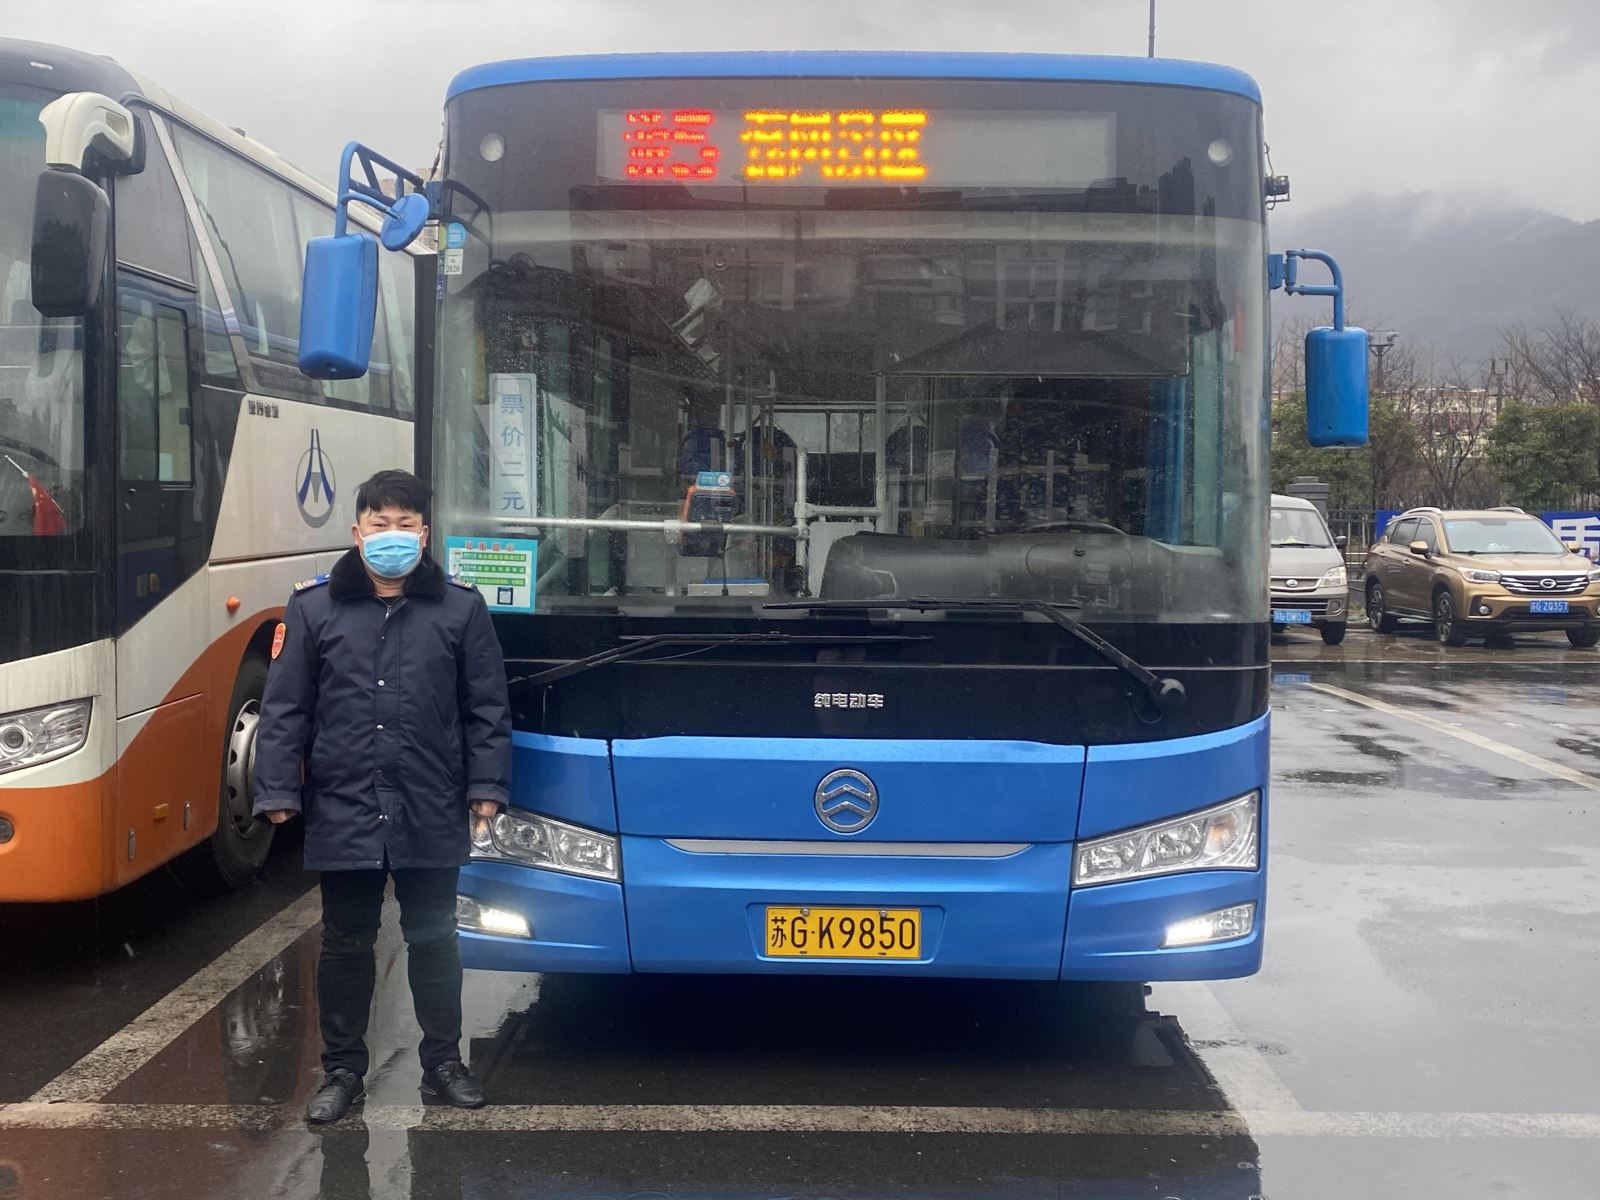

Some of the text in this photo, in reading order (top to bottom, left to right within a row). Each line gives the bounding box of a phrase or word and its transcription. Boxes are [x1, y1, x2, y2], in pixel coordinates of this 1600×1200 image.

[500, 393, 525, 511] 票价二元
[814, 693, 884, 708] 纯电动车
